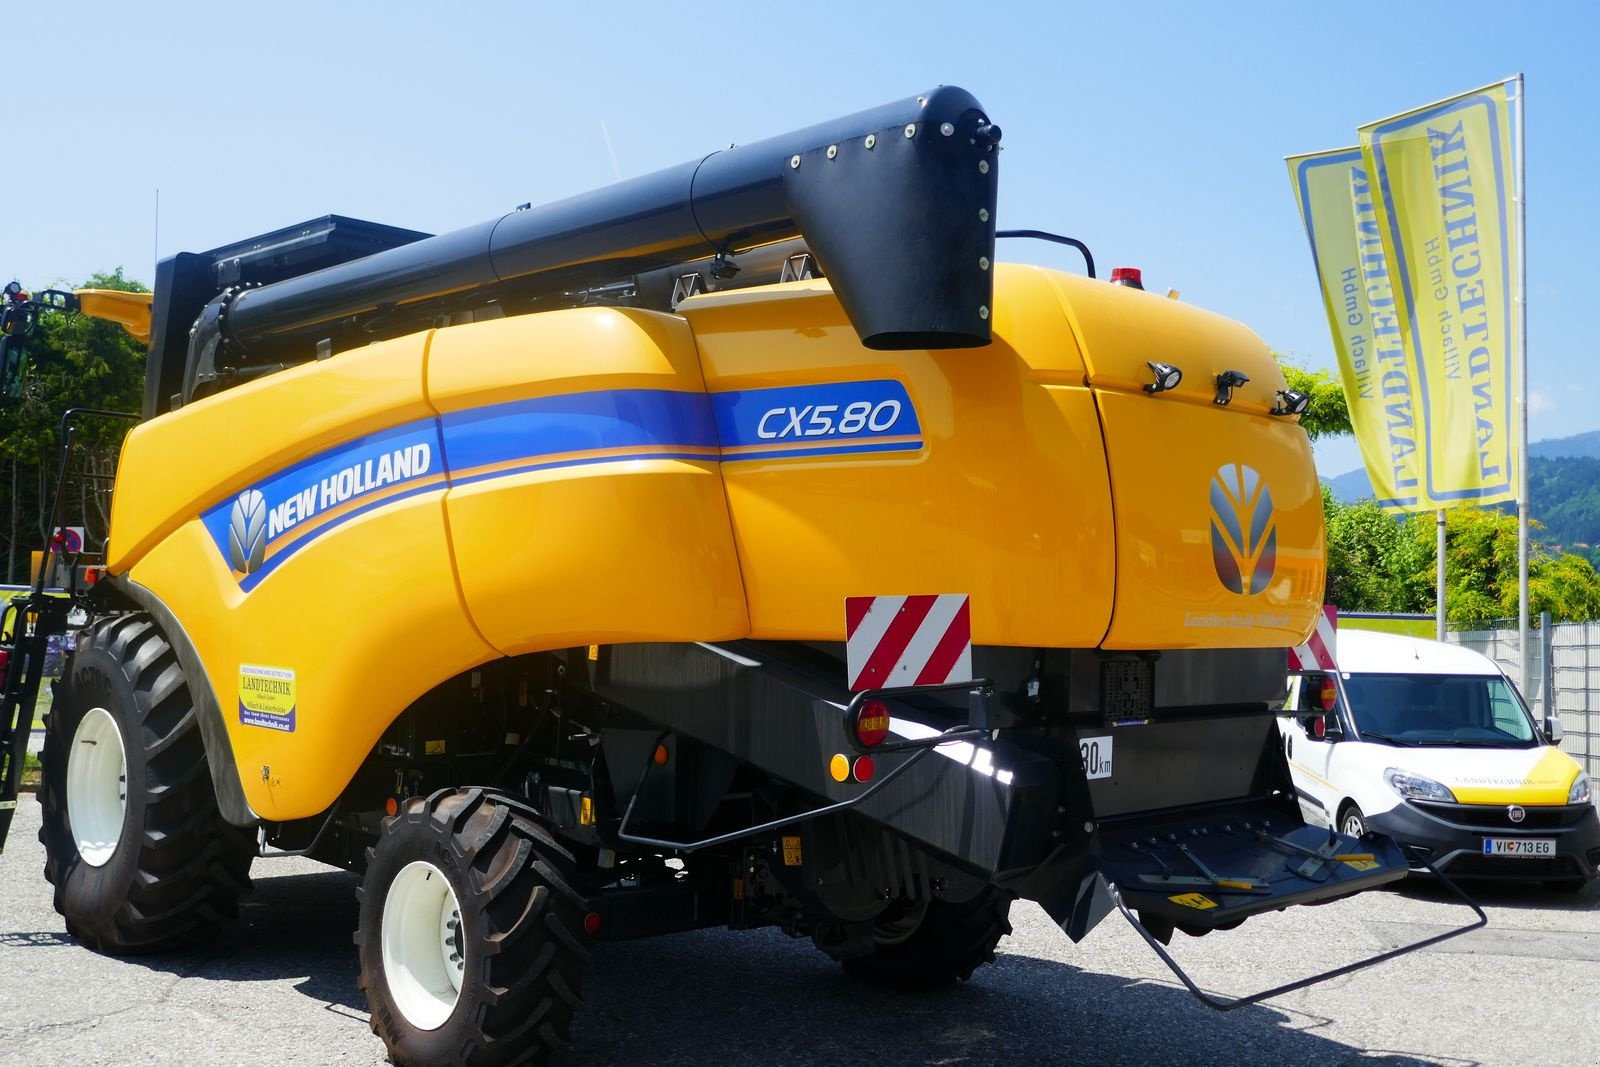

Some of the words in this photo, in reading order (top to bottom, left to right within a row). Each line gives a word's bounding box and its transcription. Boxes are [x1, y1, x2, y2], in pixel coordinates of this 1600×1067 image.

[757, 399, 901, 439] CX5.80
[268, 484, 318, 539] NEW
[320, 443, 431, 510] HOLLAND
[242, 676, 291, 695] LANDTECHNIK
[1100, 757, 1111, 774] km
[1537, 842, 1549, 853] EG
